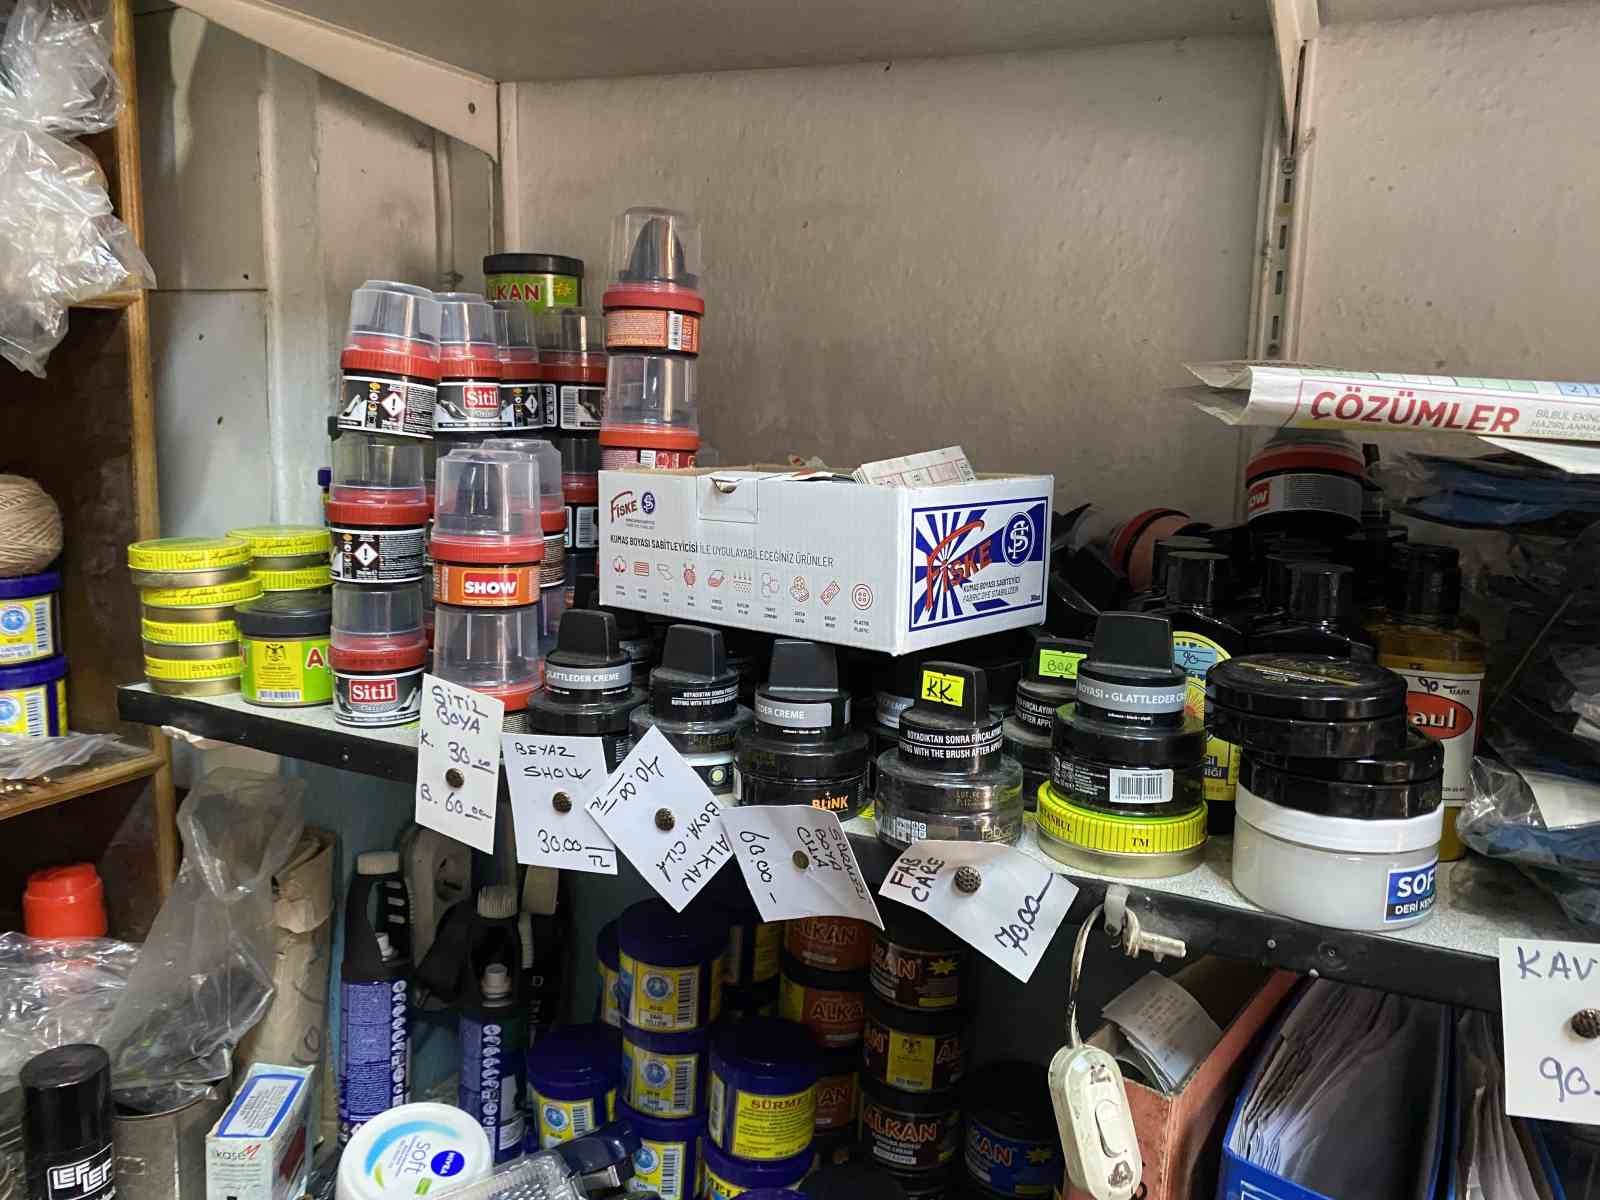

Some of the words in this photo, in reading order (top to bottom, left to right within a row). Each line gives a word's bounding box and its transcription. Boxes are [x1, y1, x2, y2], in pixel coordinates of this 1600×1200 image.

[466, 389, 498, 407] Sitil
[1310, 386, 1520, 433] ÇÖZÜMLER
[464, 580, 517, 595] SHOW
[352, 682, 395, 700] Sitil
[1111, 692, 1175, 705] GLATTLEDER
[437, 705, 481, 734] BOYA
[774, 710, 804, 720] CREME
[1410, 707, 1456, 729] aul
[945, 734, 970, 744] SONRA
[515, 742, 576, 758] BEYAZ
[913, 747, 930, 757] WITH
[931, 749, 945, 759] THE
[945, 749, 970, 759] BRUSH
[523, 766, 592, 780] SHOW
[1131, 837, 1150, 848] TM
[889, 857, 922, 888] FAB
[911, 856, 945, 903] CARE
[1397, 868, 1437, 898] SOF
[403, 1141, 431, 1175] soft
